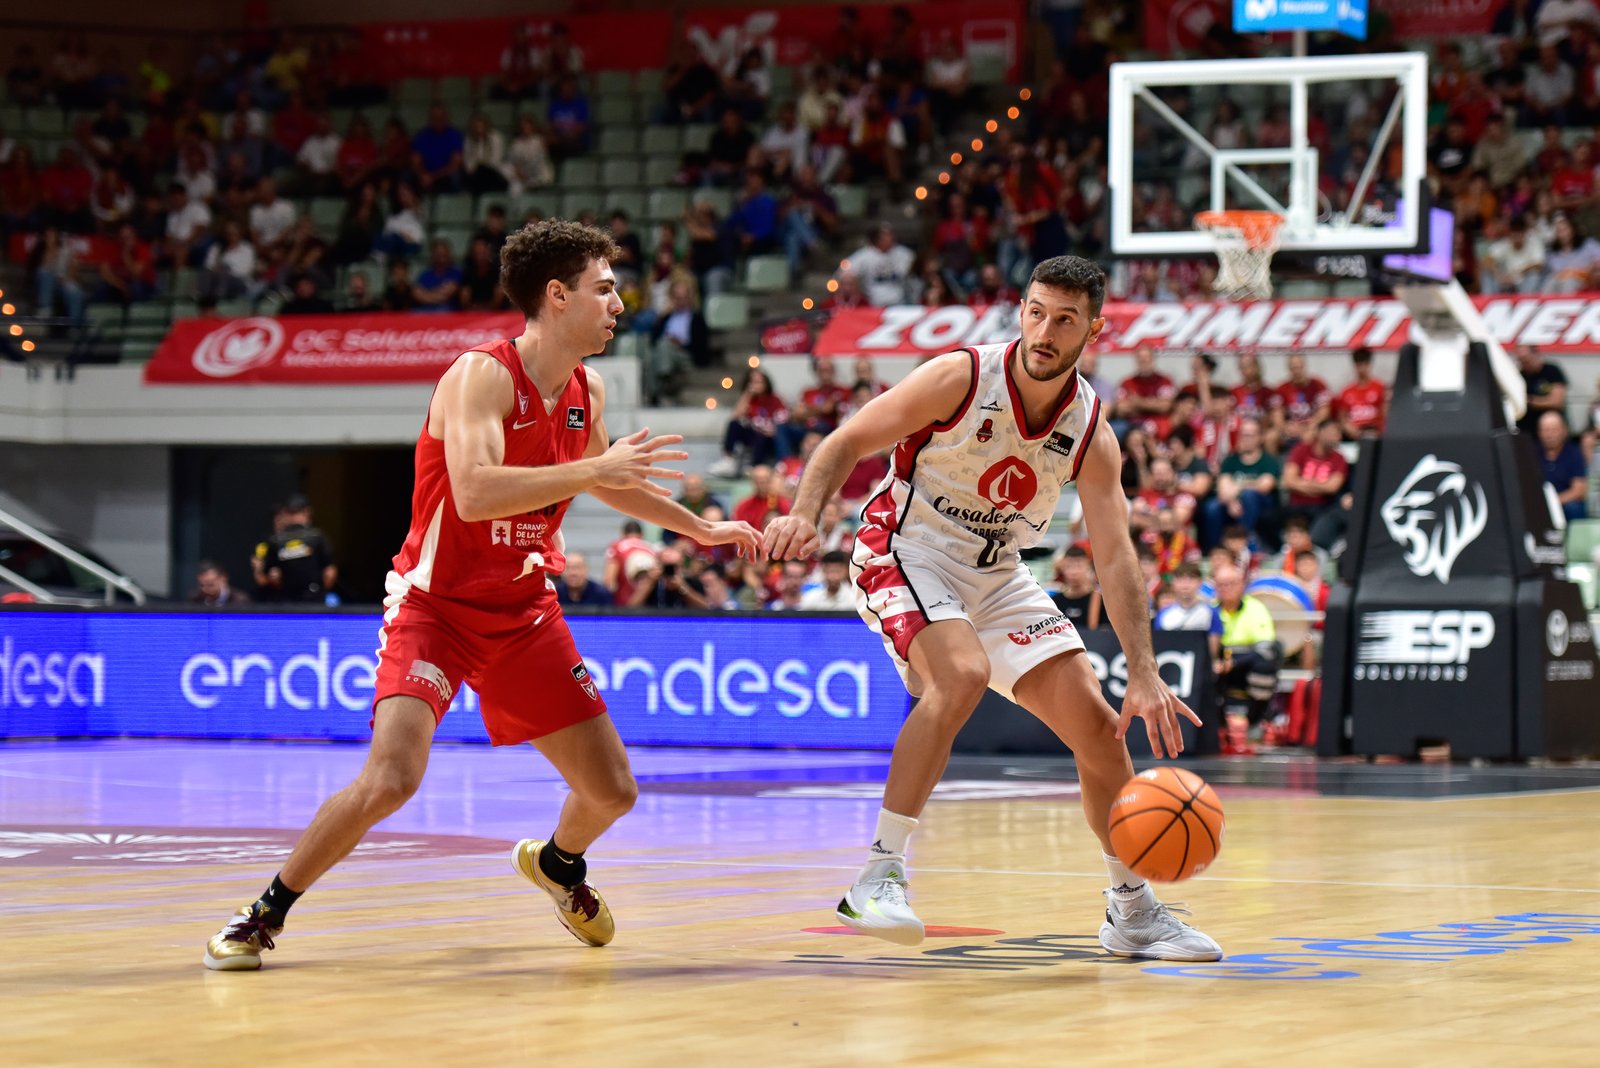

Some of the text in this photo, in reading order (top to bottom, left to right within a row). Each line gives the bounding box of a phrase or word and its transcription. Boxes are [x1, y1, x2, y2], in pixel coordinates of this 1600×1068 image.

[858, 304, 1021, 349] ZON
[1357, 609, 1496, 664] ESP
[1354, 664, 1468, 681] SOLUTIONS
